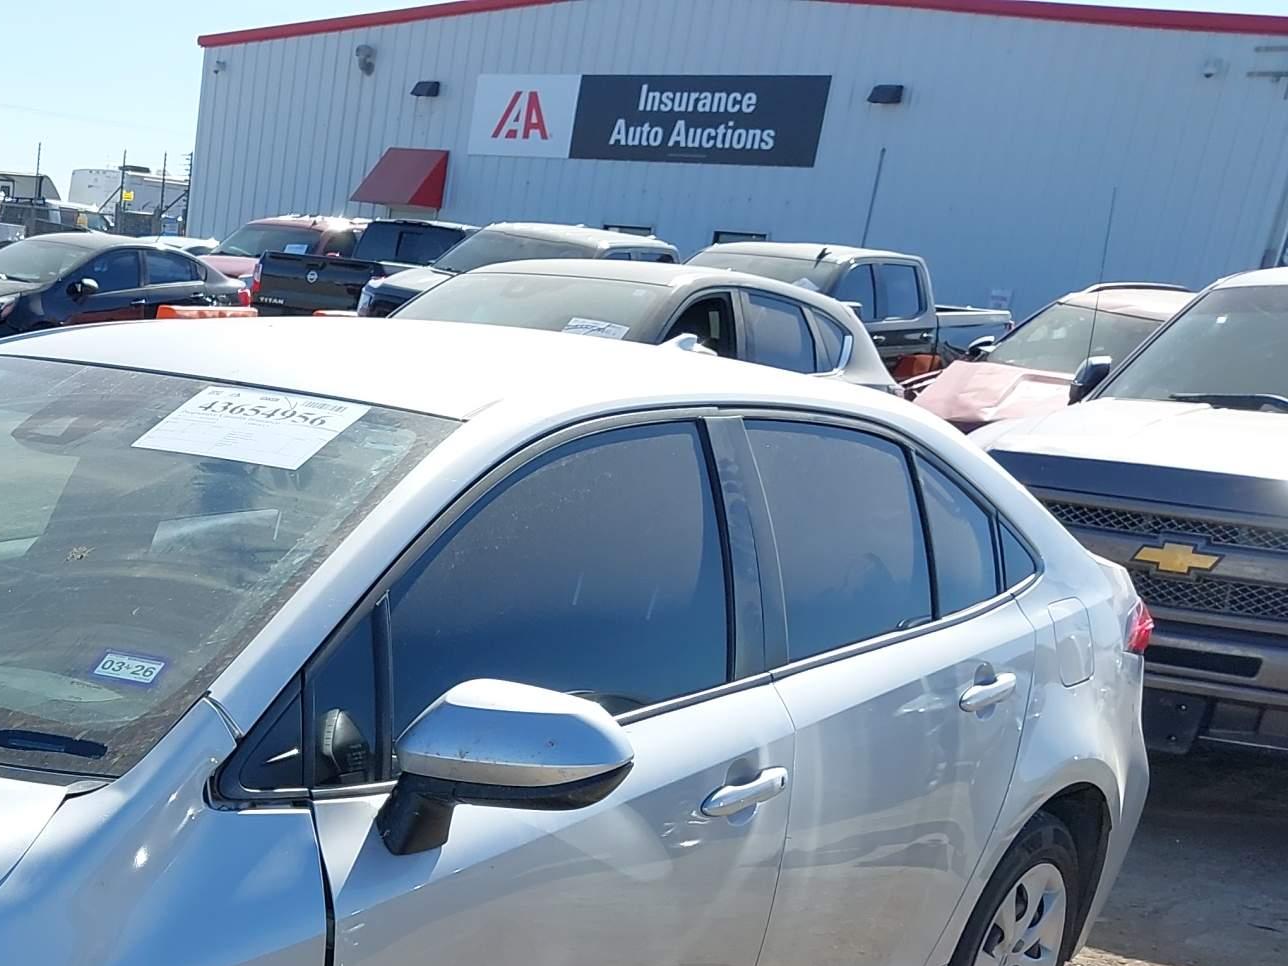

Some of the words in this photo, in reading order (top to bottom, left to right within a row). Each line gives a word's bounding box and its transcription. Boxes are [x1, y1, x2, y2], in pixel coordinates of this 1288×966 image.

[638, 83, 757, 114] Insurance
[608, 118, 663, 148] Auto
[667, 120, 776, 151] Auctions
[259, 296, 285, 304] TITAN
[198, 400, 333, 426] 43654956
